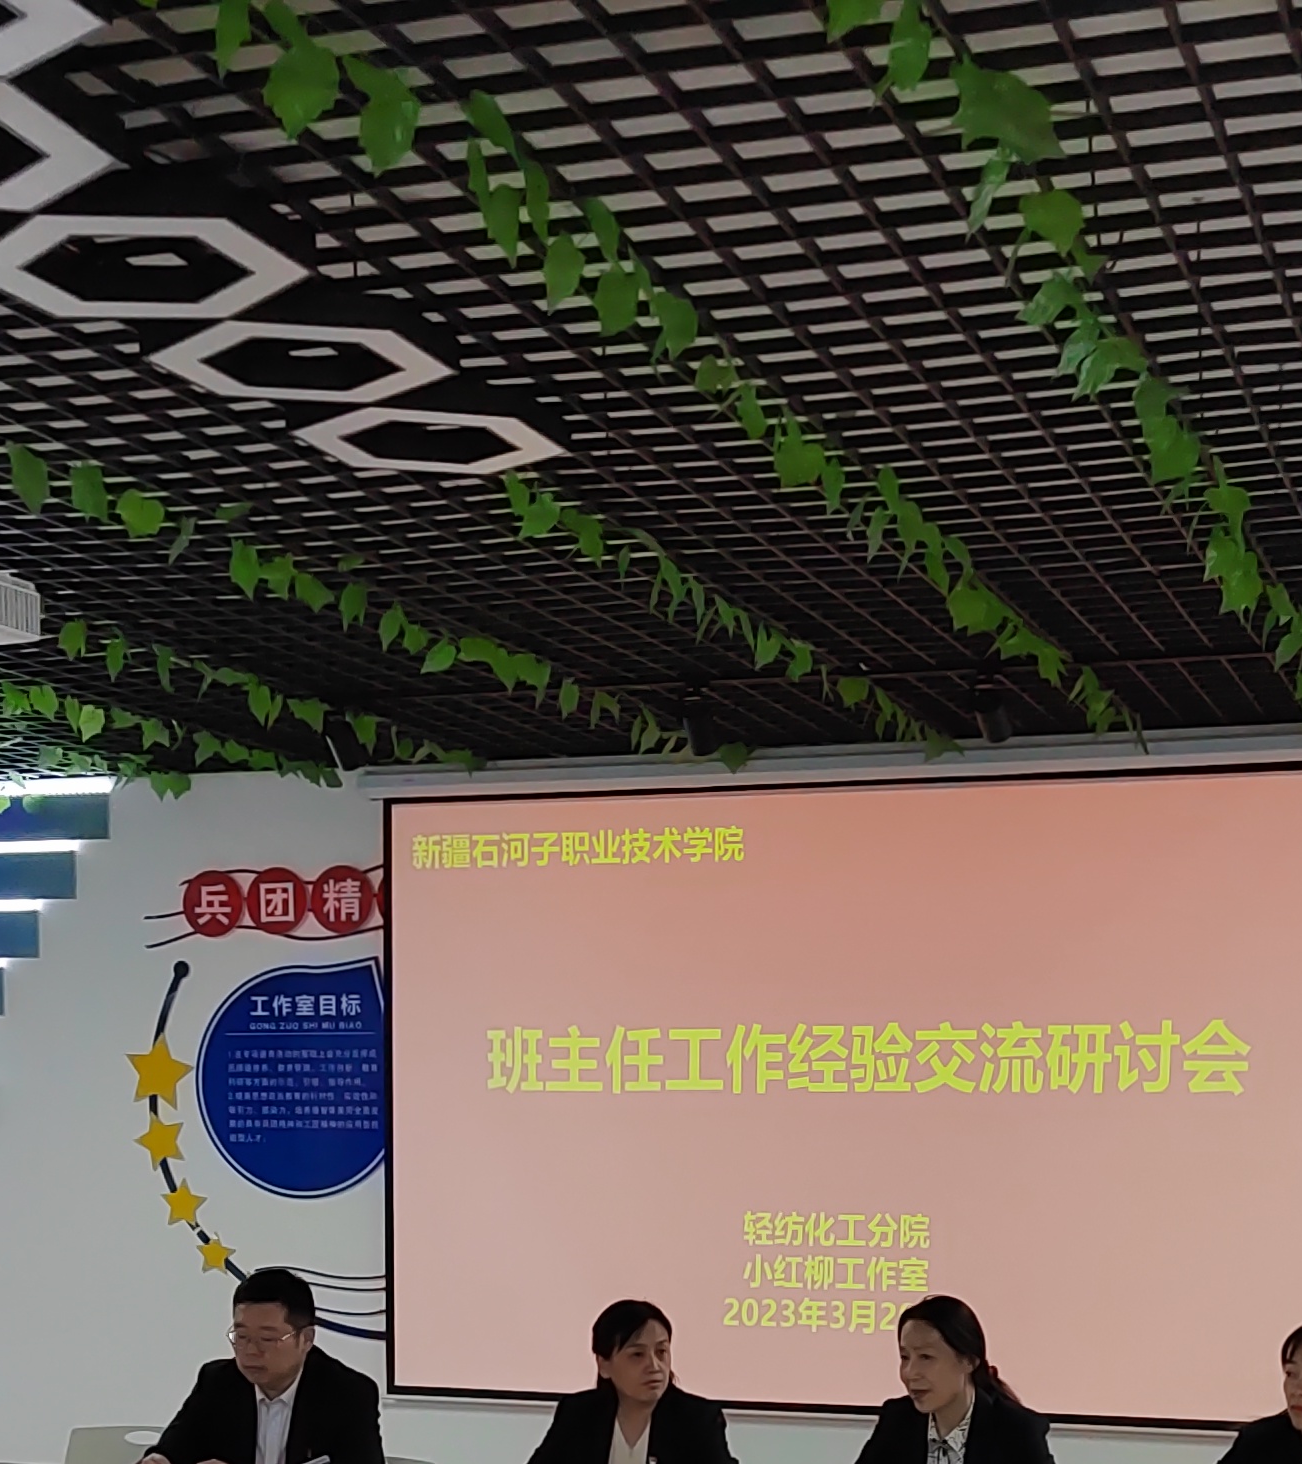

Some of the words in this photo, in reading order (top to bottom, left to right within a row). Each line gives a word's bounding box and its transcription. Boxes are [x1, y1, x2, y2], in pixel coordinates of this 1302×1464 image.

[412, 826, 744, 869] 新疆石河子职业技术学院
[250, 993, 362, 1017] 工作室目标
[249, 1022, 276, 1030] GONG
[279, 1022, 299, 1030] ZUO
[302, 1022, 318, 1030] SHI
[487, 1019, 1251, 1096] 班主任工作经验交流研讨会
[743, 1211, 930, 1249] 轻纺化工分院
[743, 1254, 929, 1292] 小红柳工作室
